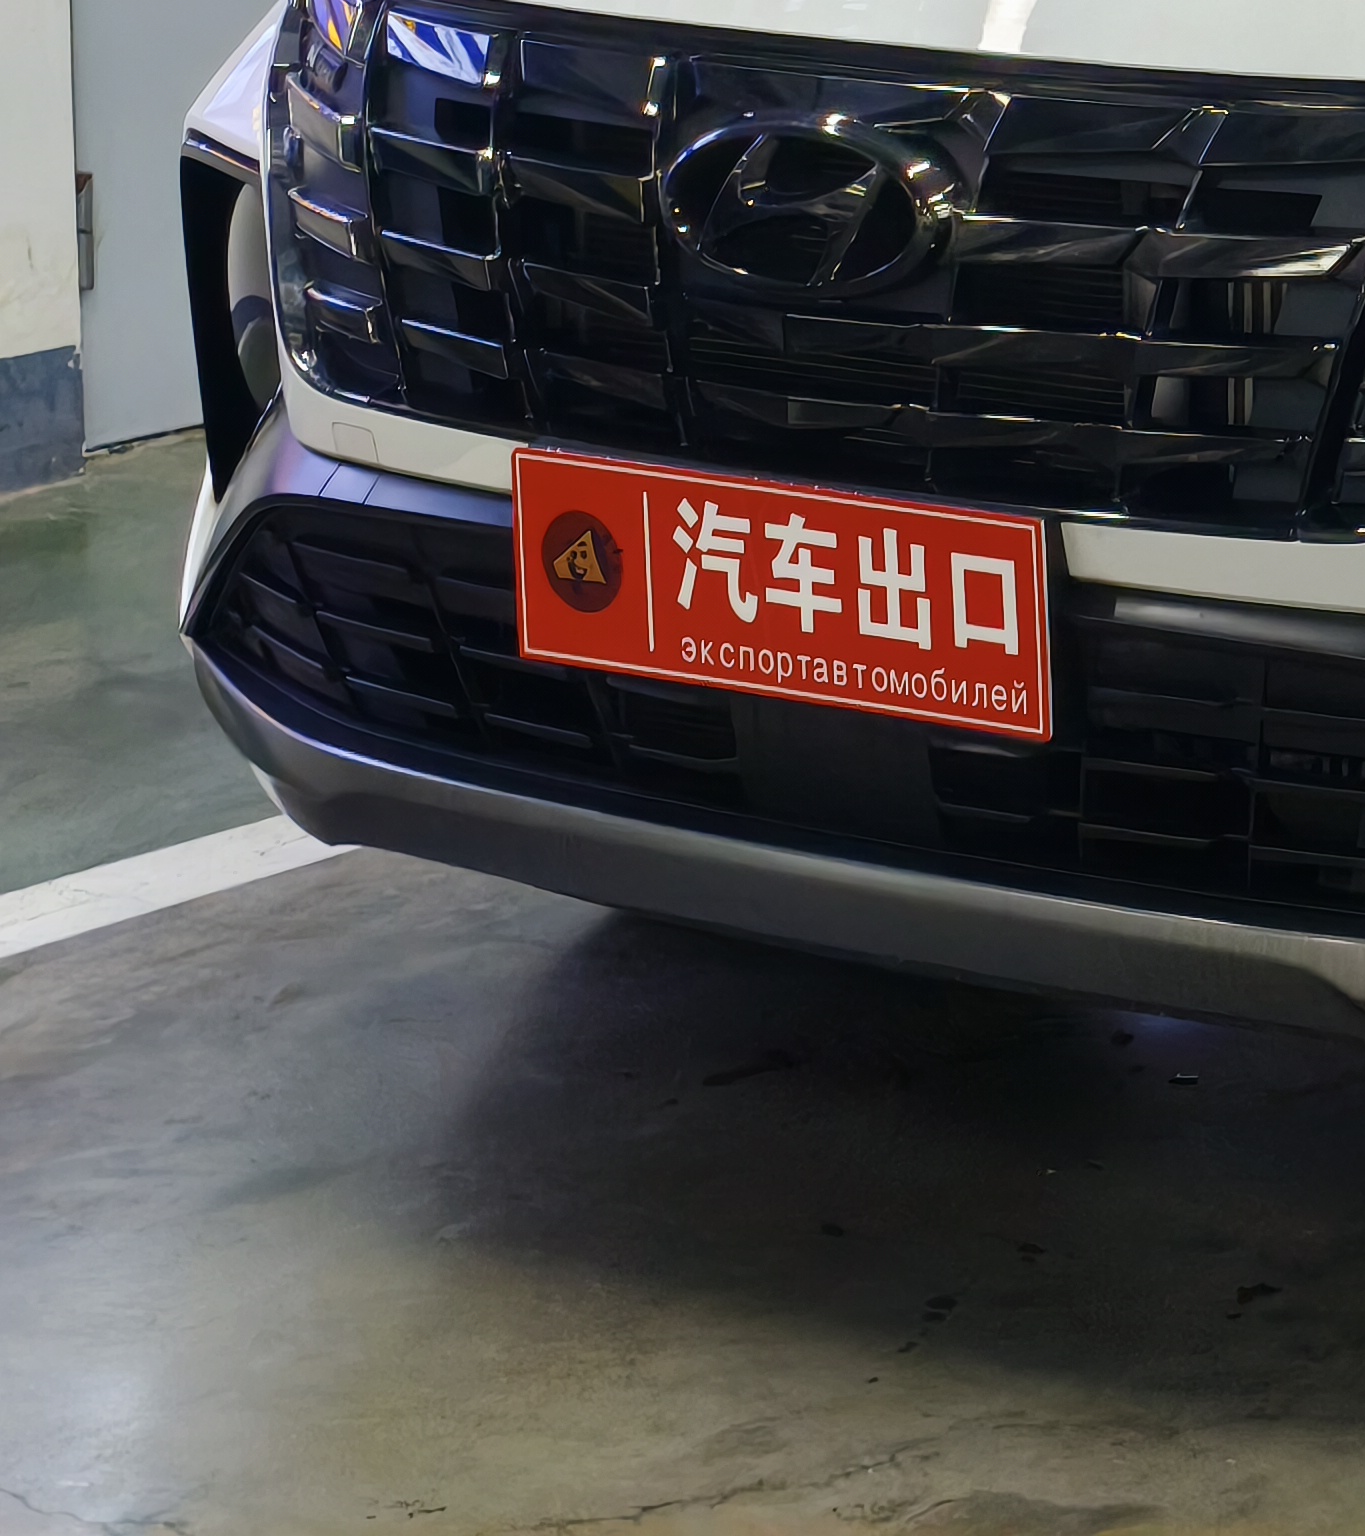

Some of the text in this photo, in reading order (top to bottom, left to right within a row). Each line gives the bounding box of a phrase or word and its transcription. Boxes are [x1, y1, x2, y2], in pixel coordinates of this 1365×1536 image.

[671, 496, 1020, 656] 汽车出口
[680, 635, 1029, 716] экспортавтомобилей
